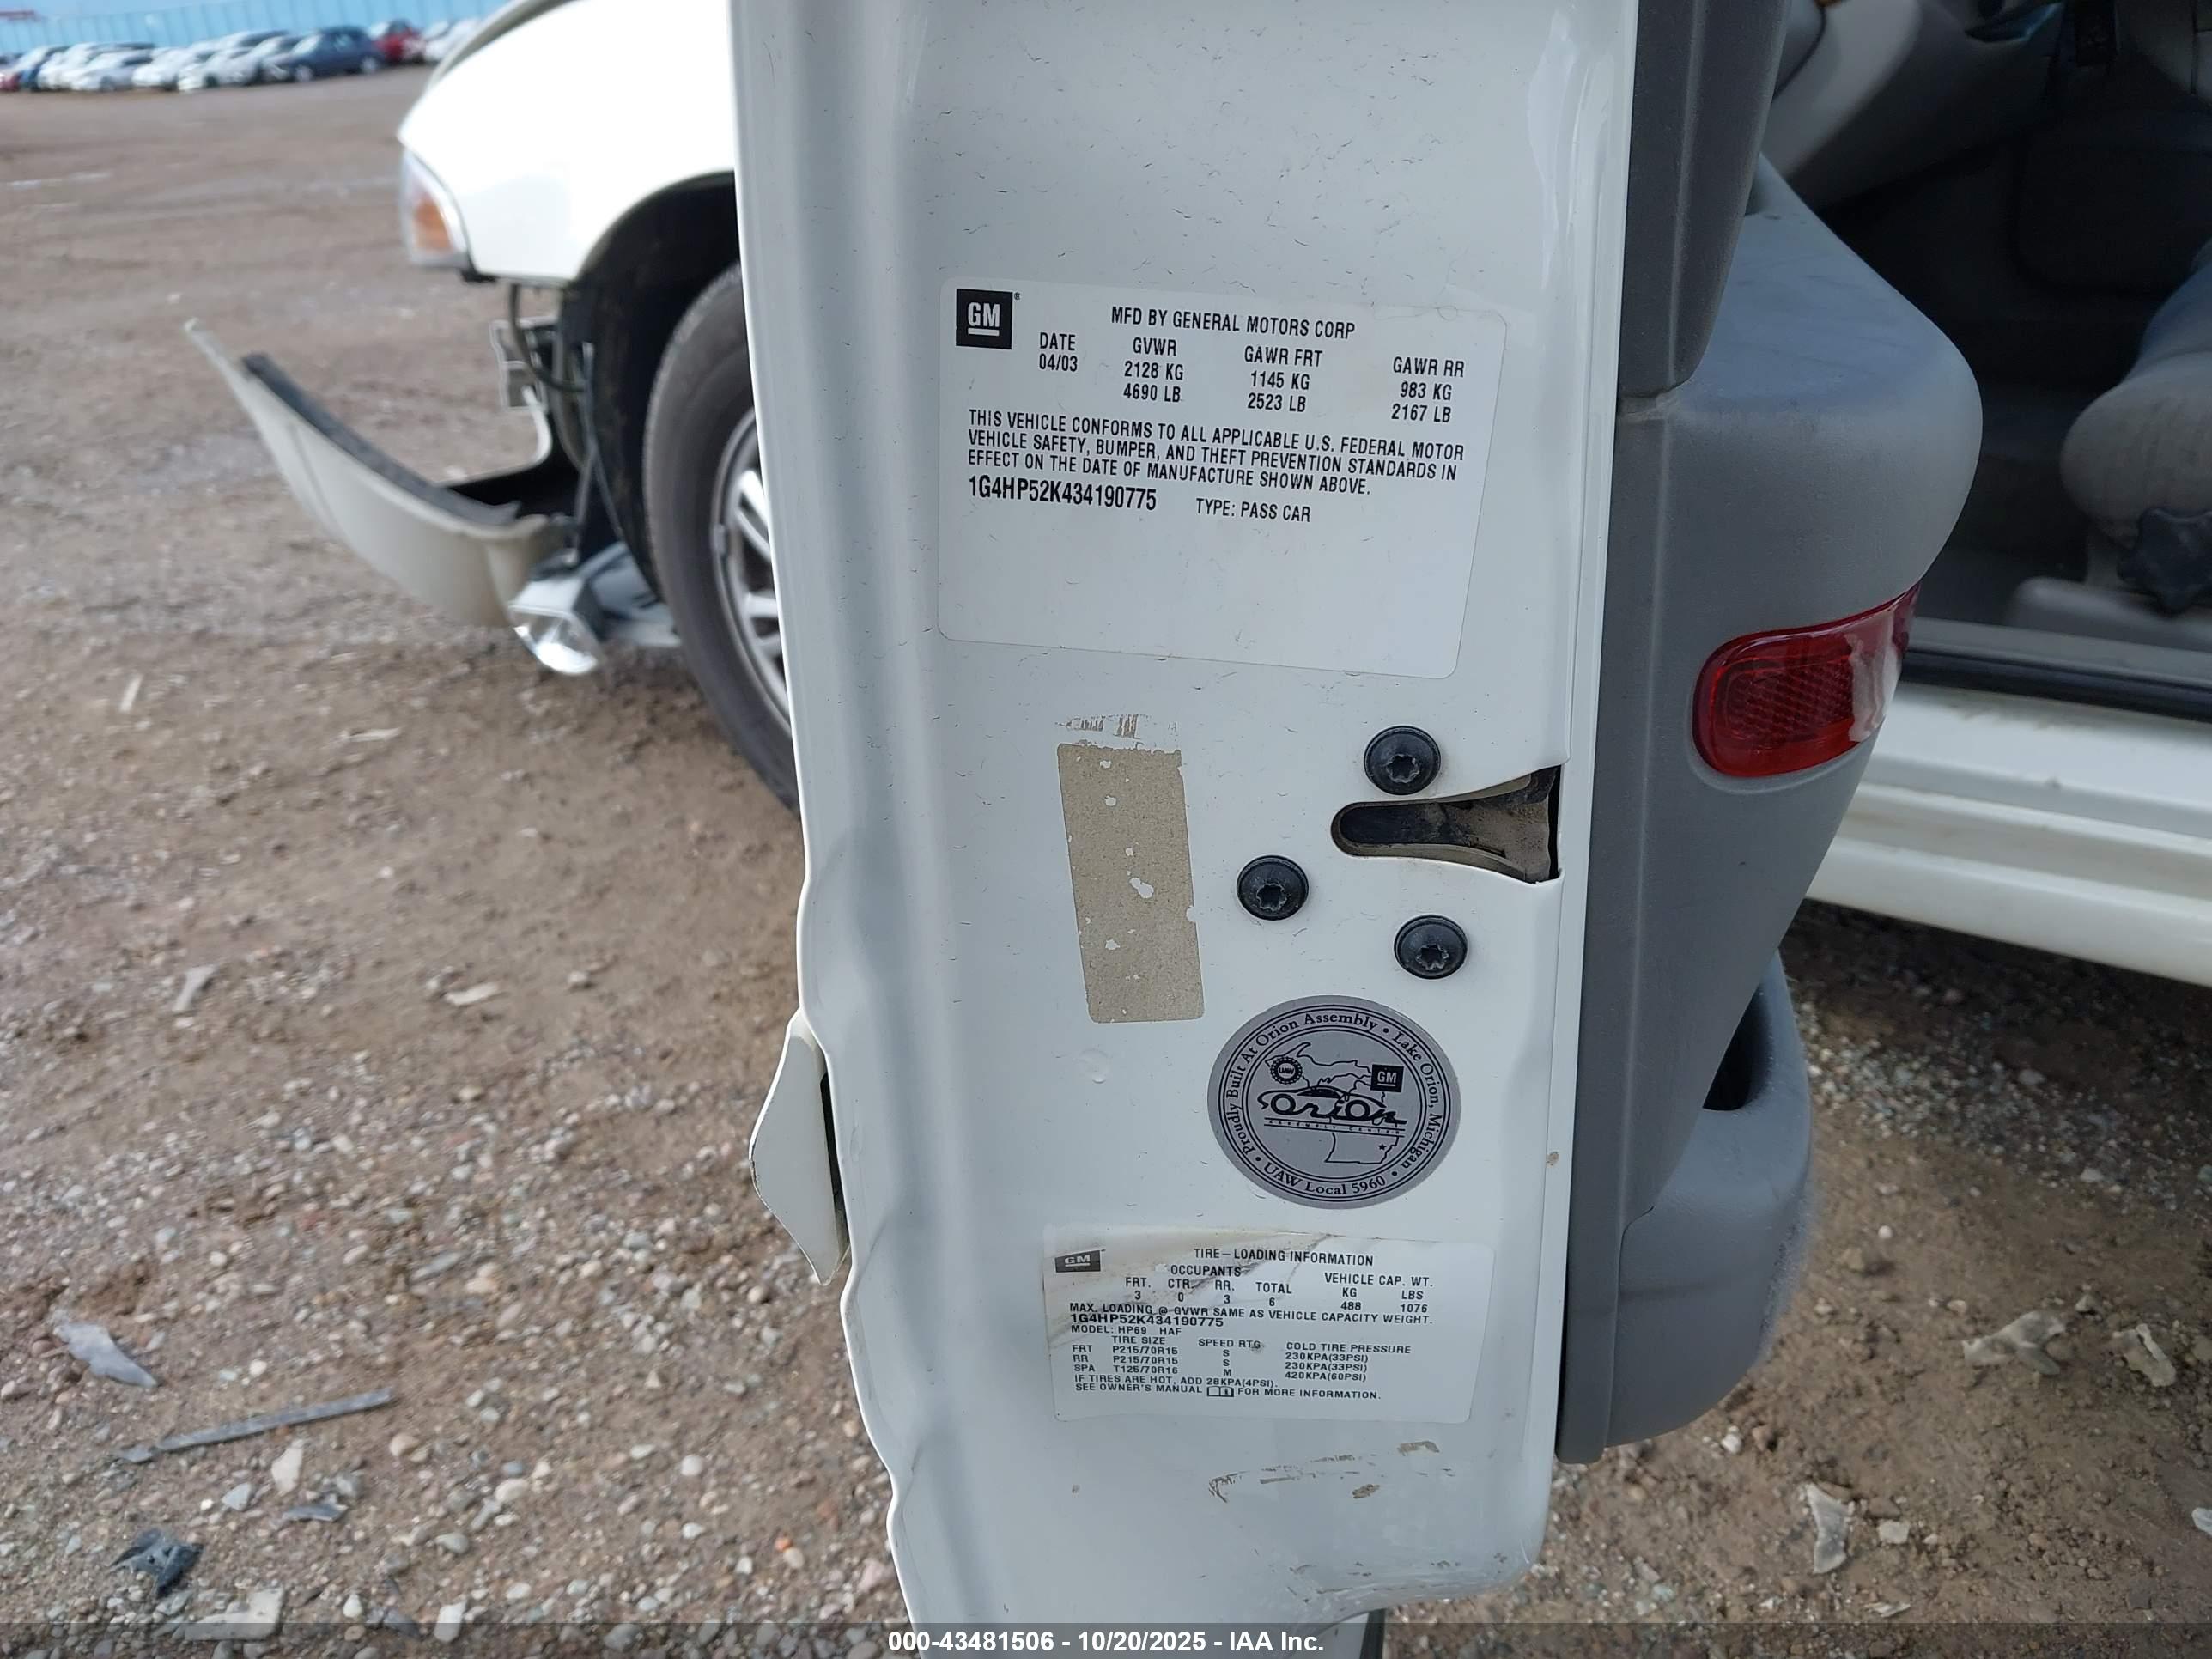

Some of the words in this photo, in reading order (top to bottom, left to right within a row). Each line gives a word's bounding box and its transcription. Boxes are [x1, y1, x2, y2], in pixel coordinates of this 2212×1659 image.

[968, 302, 1000, 328] GM
[1112, 307, 1141, 325] MFD
[1148, 309, 1167, 326] BY
[1173, 311, 1239, 331] GENERAL
[1247, 316, 1310, 337] MOTORS
[1315, 321, 1355, 339] CORP
[1040, 332, 1076, 351] DATE
[1133, 337, 1176, 356] GVWR
[1039, 353, 1078, 372] 04/03
[1244, 345, 1288, 365] GAWR
[1294, 349, 1322, 367] FRT
[1124, 361, 1158, 379] 2128
[1166, 363, 1183, 380] KG
[1393, 356, 1438, 375] GAWR
[1443, 360, 1465, 377] RR
[1250, 370, 1285, 388] 1145
[1291, 373, 1310, 390] KG
[1123, 383, 1158, 401] 4690
[1164, 386, 1181, 403] LB
[1400, 381, 1426, 398] 983
[1432, 383, 1452, 401] KG
[1247, 392, 1283, 410] 2523
[1289, 395, 1306, 412] LB
[1391, 403, 1427, 422] 2167
[1433, 405, 1451, 423] LB
[969, 409, 1002, 427] THIS
[1007, 411, 1066, 432] VEHICLE
[1073, 416, 1152, 438] CONFORMS
[1158, 422, 1175, 440] TO
[1181, 425, 1206, 443] ALL
[1212, 428, 1299, 450] APPLICABLE
[1305, 434, 1334, 453] U.S.
[1340, 437, 1405, 458] FEDERAL
[1412, 441, 1464, 461] MOTOR
[969, 429, 1027, 449] VEHICLE
[1033, 434, 1091, 456] SAFETY,
[1096, 439, 1160, 461] BUMPER,
[1166, 444, 1195, 462] AND
[1201, 447, 1247, 465] THEFT
[1251, 450, 1342, 473] PREVENTION
[1348, 458, 1437, 479] STANDARDS
[1442, 464, 1457, 481] IN
[968, 449, 1019, 468] EFFECT
[1025, 453, 1043, 470] ON
[1050, 455, 1076, 472] THE
[1083, 458, 1117, 476] DATE
[1124, 460, 1141, 477] OF
[1147, 463, 1253, 486] MANUFACTURE
[1260, 472, 1314, 491] SHOWN
[1319, 477, 1370, 495] ABOVE.
[969, 475, 1157, 511] 1G4HP52K434190775
[1196, 498, 1235, 517] TYPE:
[1241, 501, 1278, 520] PASS
[1283, 505, 1310, 522] CAR
[1304, 1013, 1378, 1034] Assembly
[1255, 1021, 1299, 1047] Orion
[1241, 1046, 1259, 1065] At
[1391, 1031, 1423, 1061] Lake
[1226, 1064, 1247, 1100] Built
[1377, 1071, 1396, 1083] GM
[1421, 1063, 1440, 1109] Orion,
[1226, 1105, 1256, 1156] Proudly
[1402, 1115, 1443, 1170] Michigan
[1264, 1164, 1301, 1187] UAW
[1305, 1180, 1346, 1195] Local
[1352, 1176, 1386, 1194] 5960
[1194, 1249, 1219, 1259] TIRE
[1234, 1249, 1285, 1261] LOADING
[1290, 1251, 1373, 1267] INFORMATION
[1170, 1265, 1241, 1277] OCCUPANTS
[1325, 1273, 1374, 1285] VEHICLE
[1379, 1275, 1406, 1286] CAP.
[1412, 1277, 1433, 1287] WT.
[1126, 1277, 1151, 1288] FRT.
[1168, 1279, 1194, 1289] CTR.
[1215, 1280, 1235, 1291] RR.
[1255, 1282, 1292, 1294] TOTAL
[1342, 1287, 1357, 1297] KG
[1401, 1290, 1424, 1300] LBS
[1134, 1291, 1141, 1300] 3
[1178, 1292, 1184, 1302] 0
[1224, 1294, 1231, 1304] 3
[1269, 1297, 1275, 1306] 6
[1340, 1301, 1361, 1310] 488
[1070, 1303, 1098, 1313] MAX.
[1103, 1304, 1153, 1315] LOADING
[1159, 1306, 1168, 1316] @
[1174, 1306, 1208, 1316] GVWR
[1212, 1308, 1244, 1317] SAME
[1249, 1310, 1265, 1318] AS
[1269, 1310, 1316, 1321] VEHICLE
[1322, 1312, 1378, 1322] CAPACITY
[1383, 1315, 1433, 1324] WEIGHT.
[1400, 1304, 1428, 1313] 1076
[1070, 1313, 1224, 1327] 1G4HP52K434190775
[1071, 1325, 1114, 1334] MODEL:
[1118, 1326, 1147, 1334] HP69
[1159, 1327, 1182, 1336] HAF
[1112, 1335, 1137, 1344] TIRE
[1141, 1336, 1165, 1345] SIZE
[1198, 1338, 1234, 1348] SPEED
[1238, 1340, 1261, 1348] RTG
[1286, 1342, 1316, 1352] COLD
[1322, 1343, 1346, 1352] TIRE
[1350, 1344, 1412, 1354] PRESSURE
[1073, 1345, 1092, 1353] FRT
[1113, 1346, 1178, 1355] P215/70R15
[1285, 1352, 1369, 1364] 230KPA(33PSI)
[1073, 1354, 1089, 1363] RR
[1113, 1355, 1178, 1365] P215/70R15
[1223, 1358, 1230, 1367] S
[1285, 1361, 1368, 1373] 230KPA(33PSI)
[1089, 1375, 1121, 1383] TIRES
[1181, 1376, 1203, 1385] ADD
[1114, 1364, 1178, 1375] T125/70R16
[1223, 1368, 1232, 1376] M
[1285, 1371, 1367, 1382] 420KPA(60PSI)
[1075, 1382, 1096, 1391] SEE
[1100, 1383, 1152, 1392] OWNER'S
[1156, 1385, 1203, 1394] MANUAL
[1264, 1389, 1296, 1397] MORE
[1299, 1389, 1382, 1400] INFORMATION.
